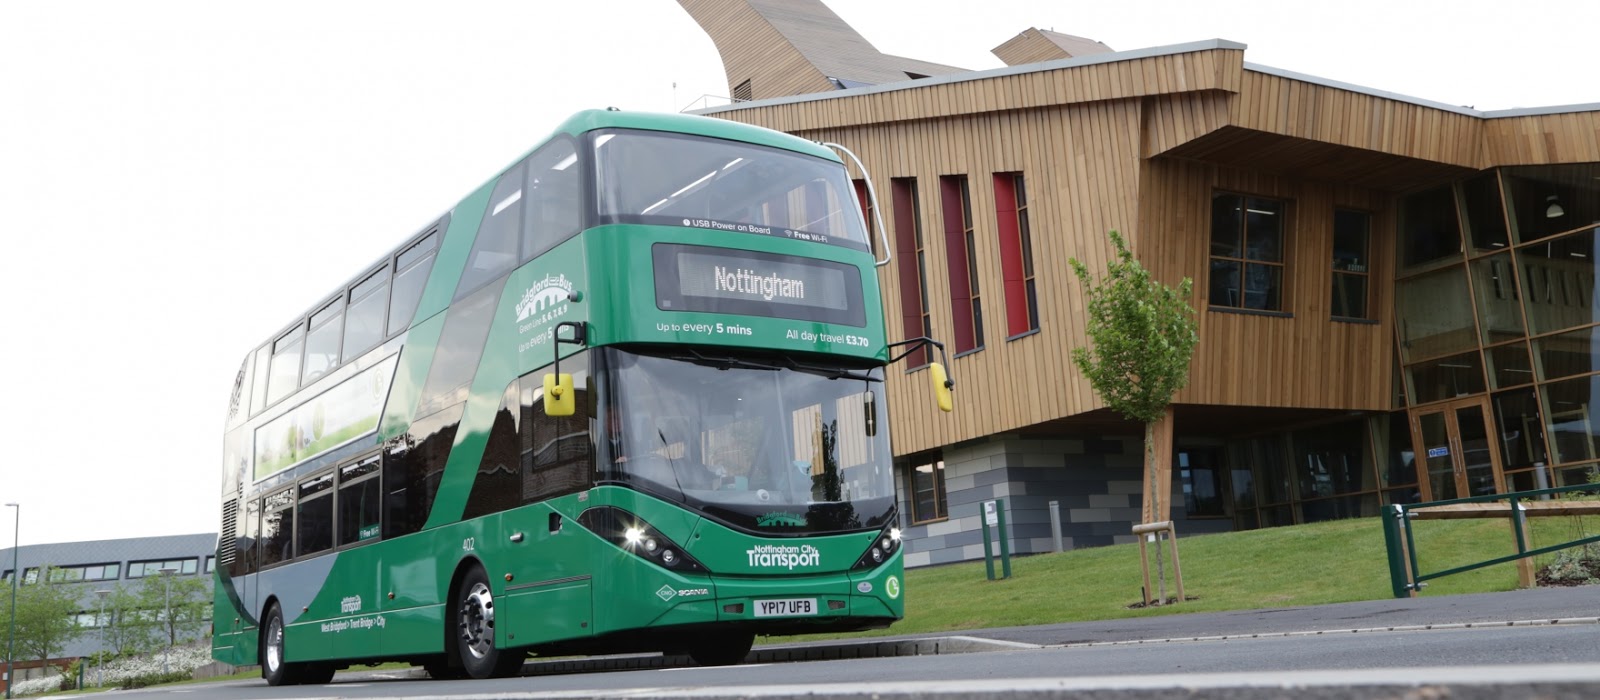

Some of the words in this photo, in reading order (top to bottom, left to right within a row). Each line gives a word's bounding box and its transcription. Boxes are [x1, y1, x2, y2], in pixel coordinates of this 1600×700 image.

[692, 219, 710, 228] USB
[711, 221, 736, 231] Power
[749, 225, 771, 234] Board
[793, 231, 810, 240] Free
[810, 233, 828, 243] Wi-Fi
[714, 265, 804, 300] Nottingham
[515, 273, 549, 317] Bridgford
[559, 273, 572, 292] Bus
[656, 322, 670, 333] Up
[671, 323, 681, 332] to
[682, 323, 714, 336] every
[716, 322, 724, 334] 5
[726, 324, 752, 336] mins
[530, 332, 547, 347] every
[547, 327, 553, 339] 5
[786, 329, 799, 340] All
[801, 331, 818, 344] day
[820, 333, 845, 344] travel
[846, 334, 869, 347] £3.70
[462, 536, 475, 551] 402
[754, 544, 800, 555] Nottingham
[800, 544, 817, 555] City
[746, 549, 820, 571] Transport
[678, 588, 709, 597] SCANIA
[341, 600, 362, 614] Transport
[761, 601, 786, 614] YP17
[789, 600, 811, 613] UFB
[321, 623, 330, 633] West
[350, 618, 360, 629] Trent
[360, 616, 374, 630] Bridge
[376, 615, 386, 629] City
